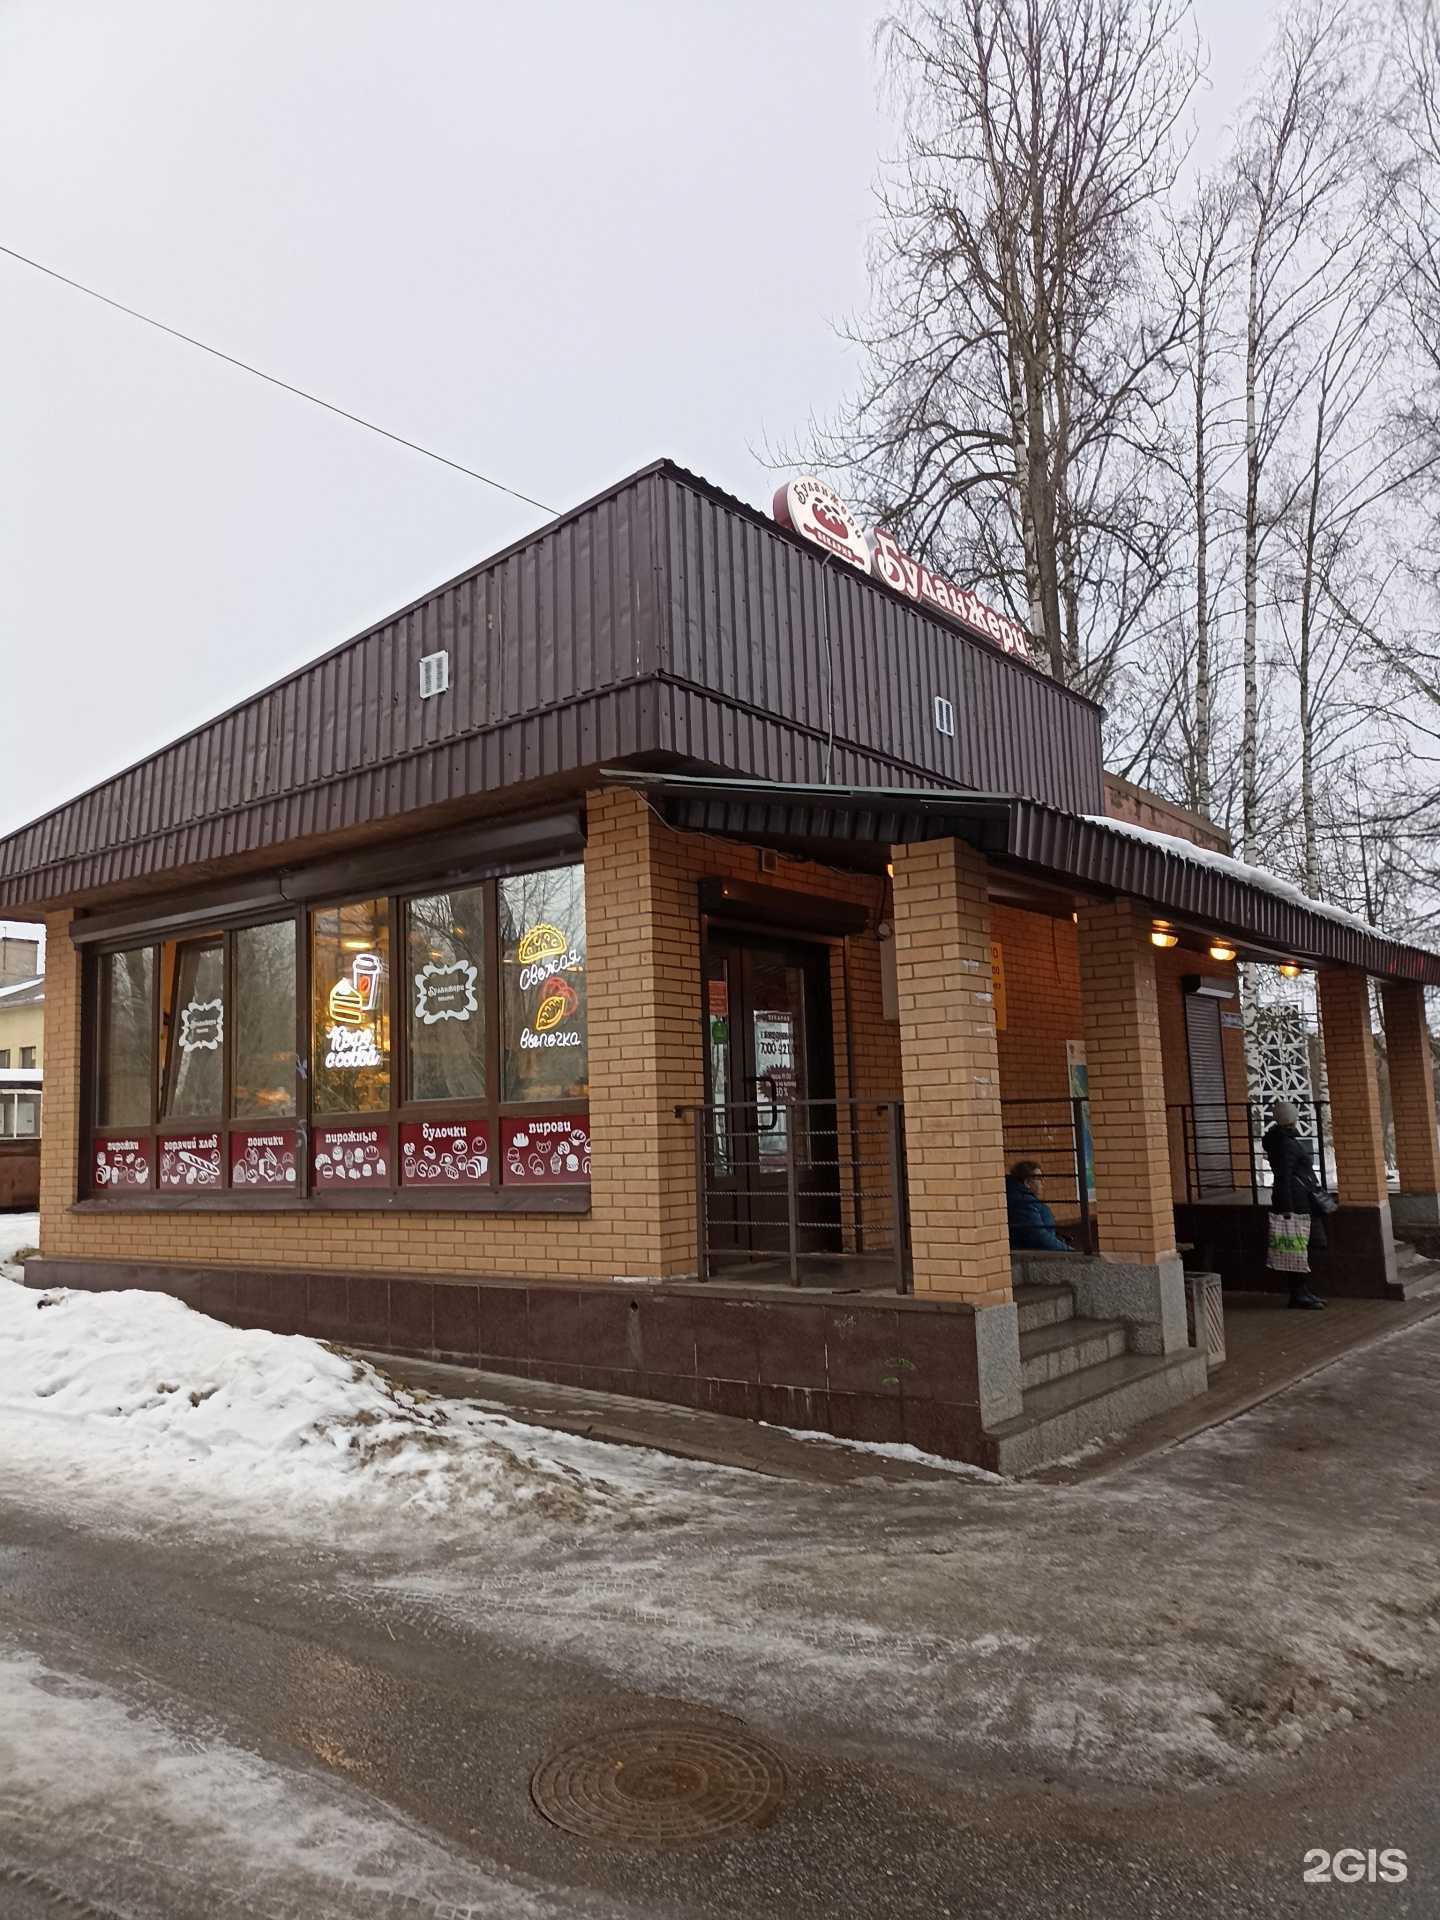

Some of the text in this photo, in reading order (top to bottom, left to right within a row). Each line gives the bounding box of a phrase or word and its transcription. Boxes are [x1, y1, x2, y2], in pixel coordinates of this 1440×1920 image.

[875, 529, 1030, 659] Буланжери
[519, 949, 582, 990] Свежая
[422, 1123, 467, 1141] булочки
[528, 1120, 571, 1136] пироги
[325, 1131, 378, 1144] пирожные
